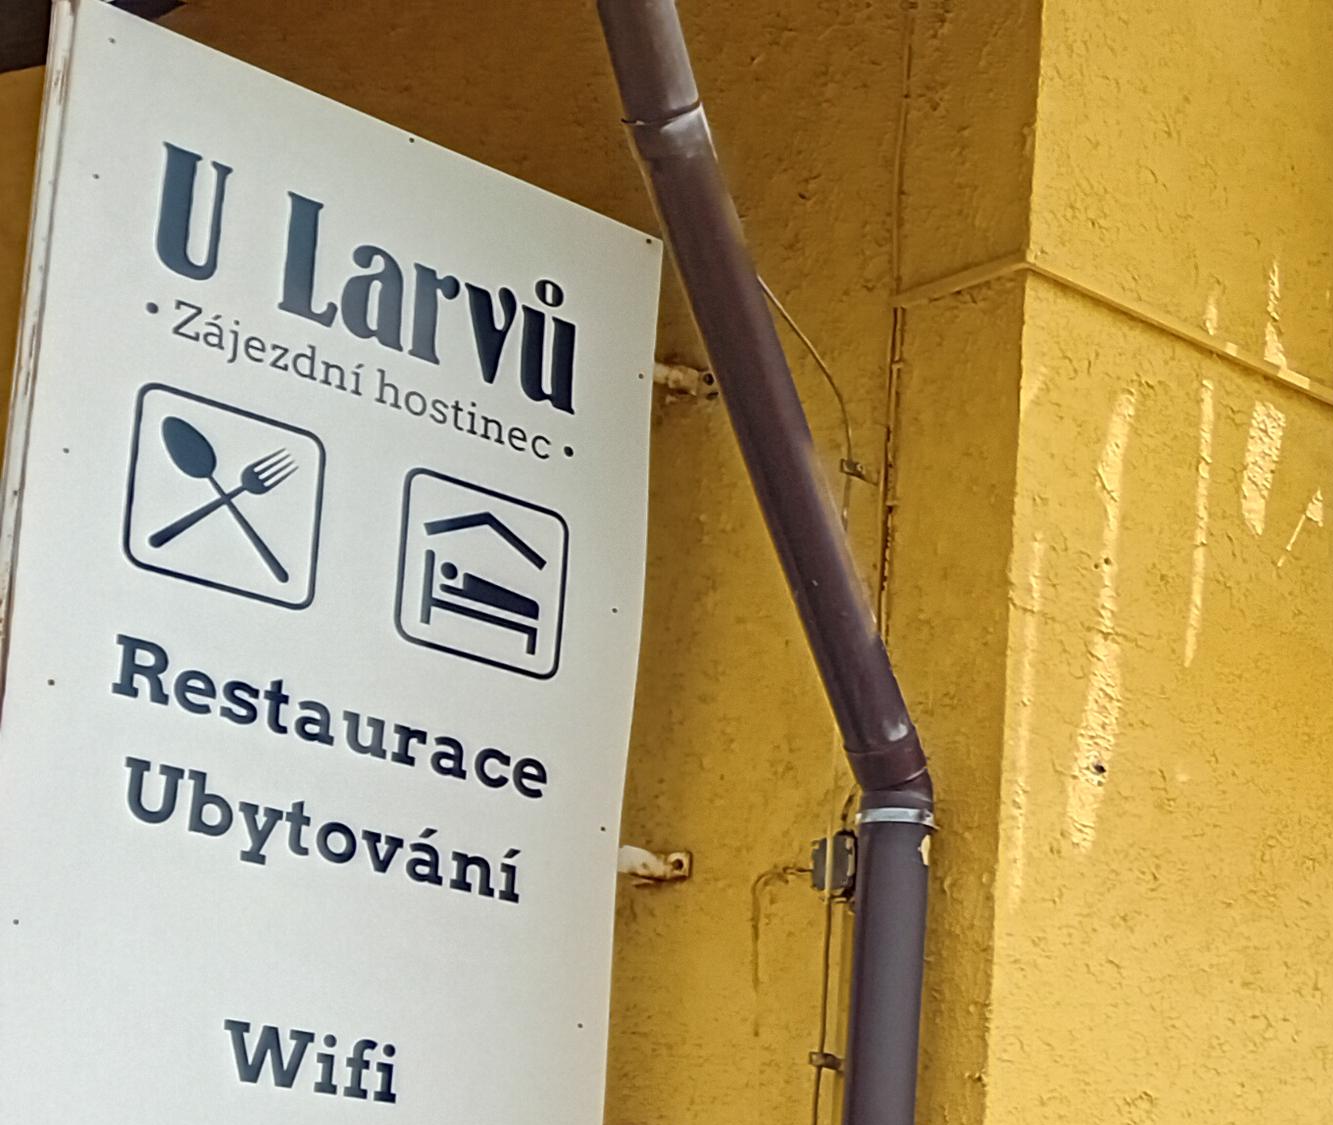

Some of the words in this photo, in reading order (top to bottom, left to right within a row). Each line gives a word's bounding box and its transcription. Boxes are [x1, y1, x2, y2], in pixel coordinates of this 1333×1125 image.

[156, 141, 234, 281] U
[278, 191, 577, 415] Larvů
[172, 299, 363, 397] Zájezdní
[375, 369, 551, 460] hostinec
[111, 633, 548, 799] Restaurace
[125, 756, 522, 904] Ubytování
[224, 1018, 397, 1105] Wifi
